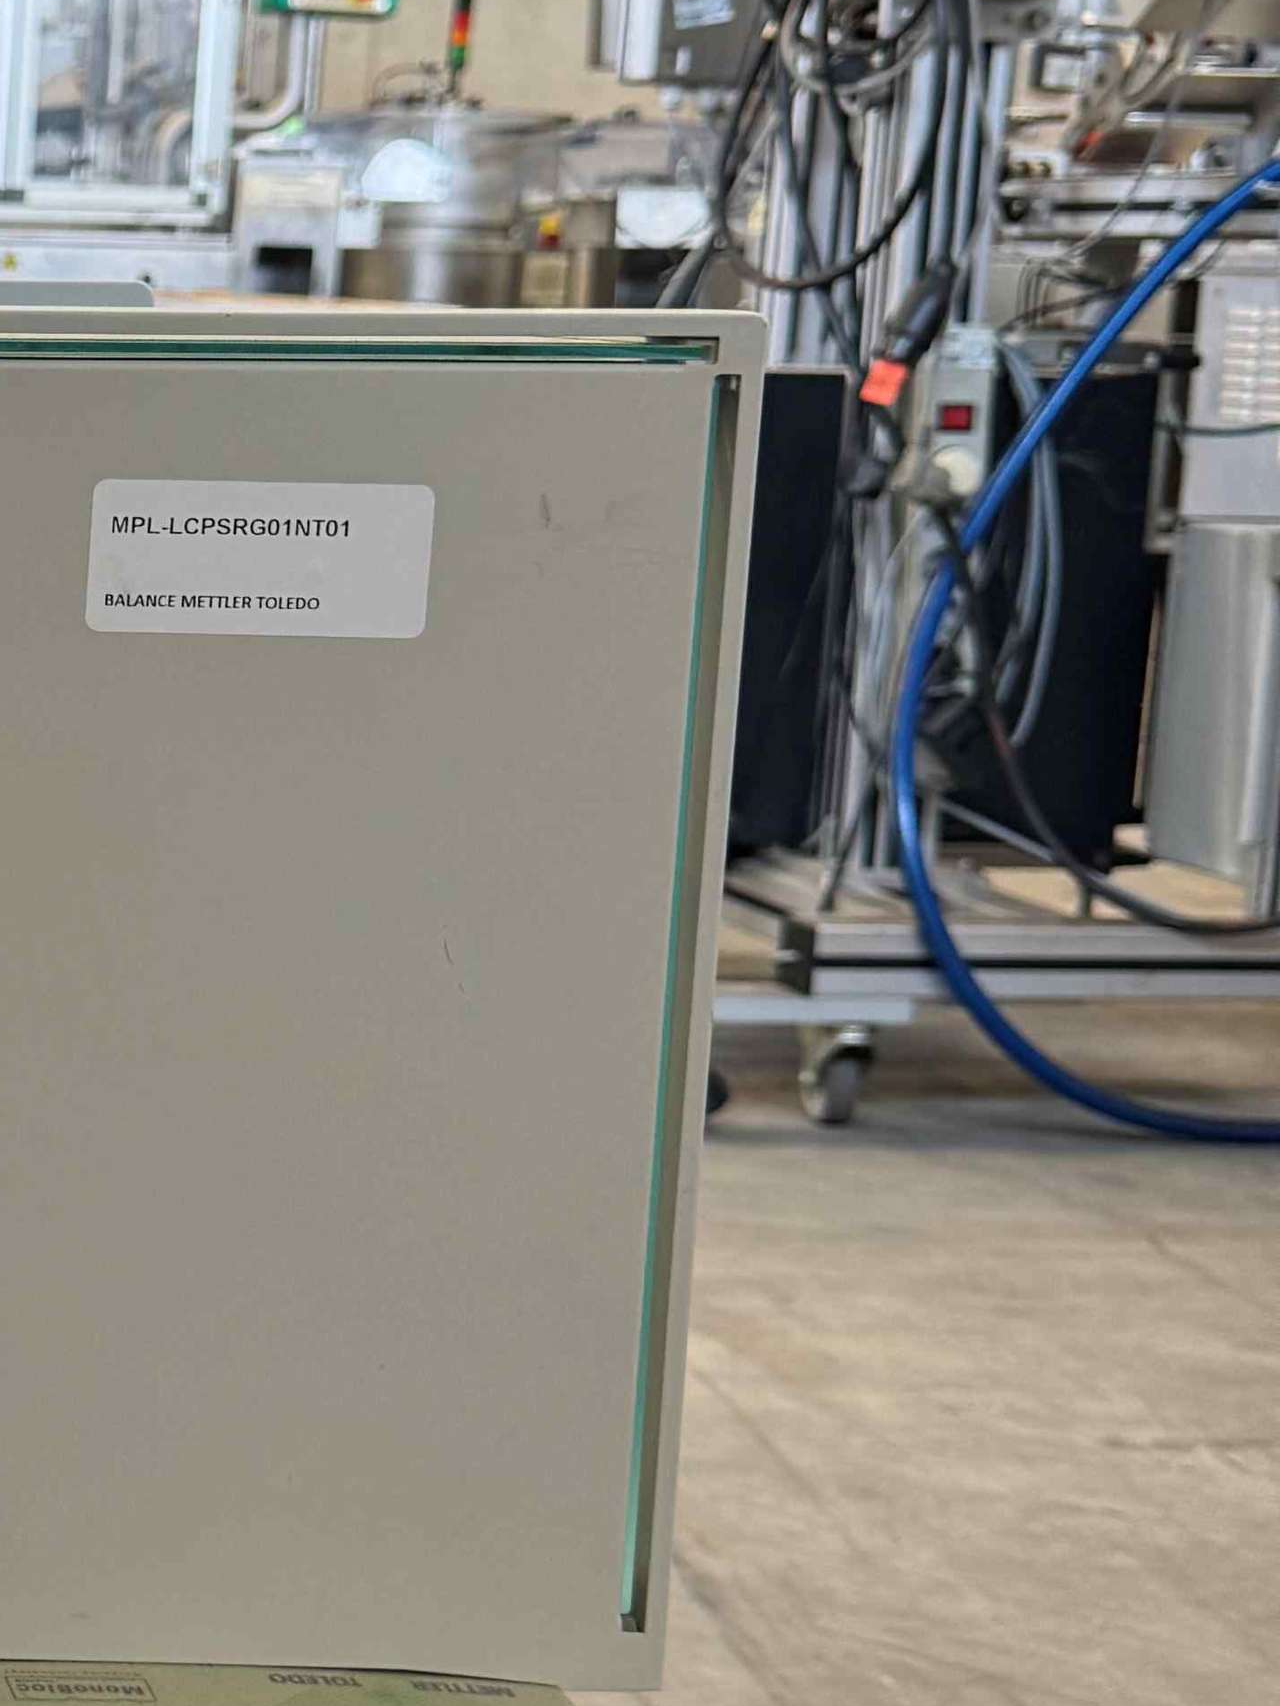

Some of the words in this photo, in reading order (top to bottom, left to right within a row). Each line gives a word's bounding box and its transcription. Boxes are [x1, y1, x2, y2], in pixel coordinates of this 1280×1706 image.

[110, 515, 351, 538] MPL-LCPSRG01NT01
[103, 593, 176, 609] BALANCE
[180, 594, 252, 610] METTLER
[256, 595, 321, 611] TOLEDO
[268, 1670, 361, 1689] TOLEDO
[410, 1677, 517, 1698] METTLER
